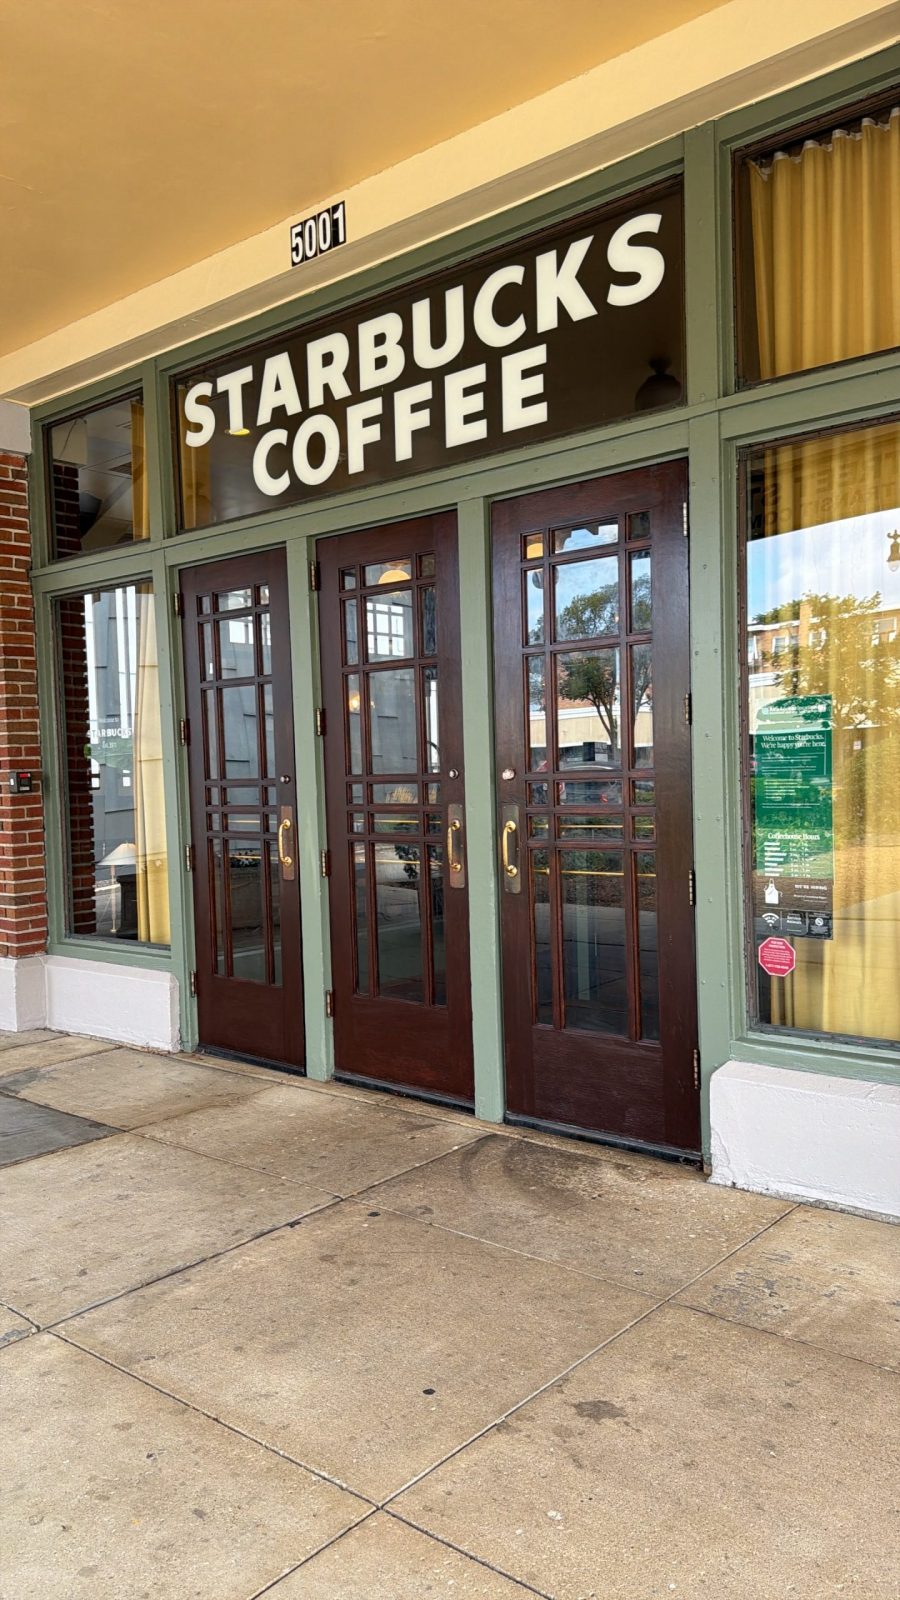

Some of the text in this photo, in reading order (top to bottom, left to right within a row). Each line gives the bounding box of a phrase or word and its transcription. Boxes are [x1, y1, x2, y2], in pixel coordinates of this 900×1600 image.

[291, 203, 345, 263] 5001
[183, 213, 666, 448] STARBUCKS
[252, 343, 548, 496] COFFEE
[762, 734, 787, 742] Welcome
[777, 741, 794, 750] happy
